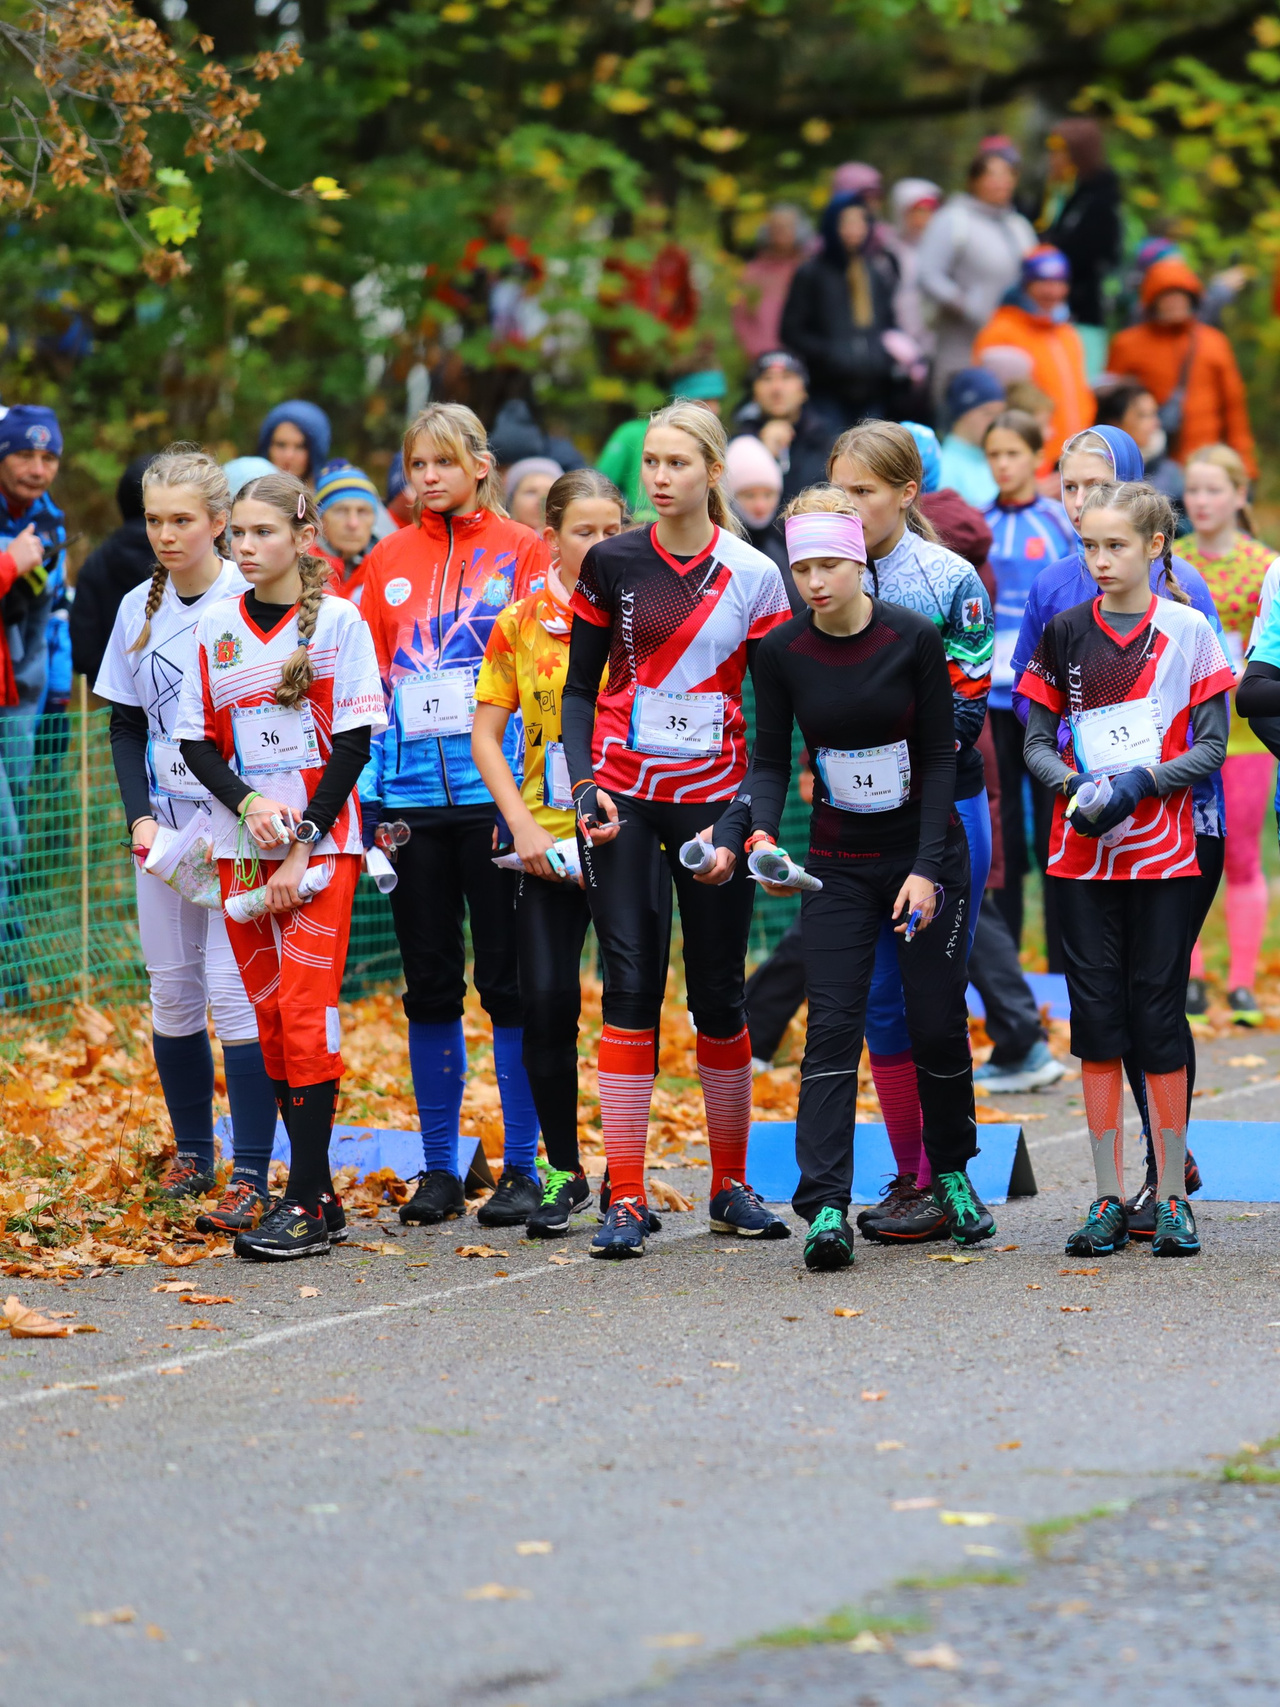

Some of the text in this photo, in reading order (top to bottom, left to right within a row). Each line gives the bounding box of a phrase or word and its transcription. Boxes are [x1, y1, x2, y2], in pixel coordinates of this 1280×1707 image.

[422, 698, 440, 714] 47
[666, 716, 688, 732] 35
[260, 730, 280, 748] 36
[1109, 726, 1130, 746] 33
[170, 762, 186, 777] 48
[852, 774, 874, 789] 34
[810, 846, 832, 858] Arctic
